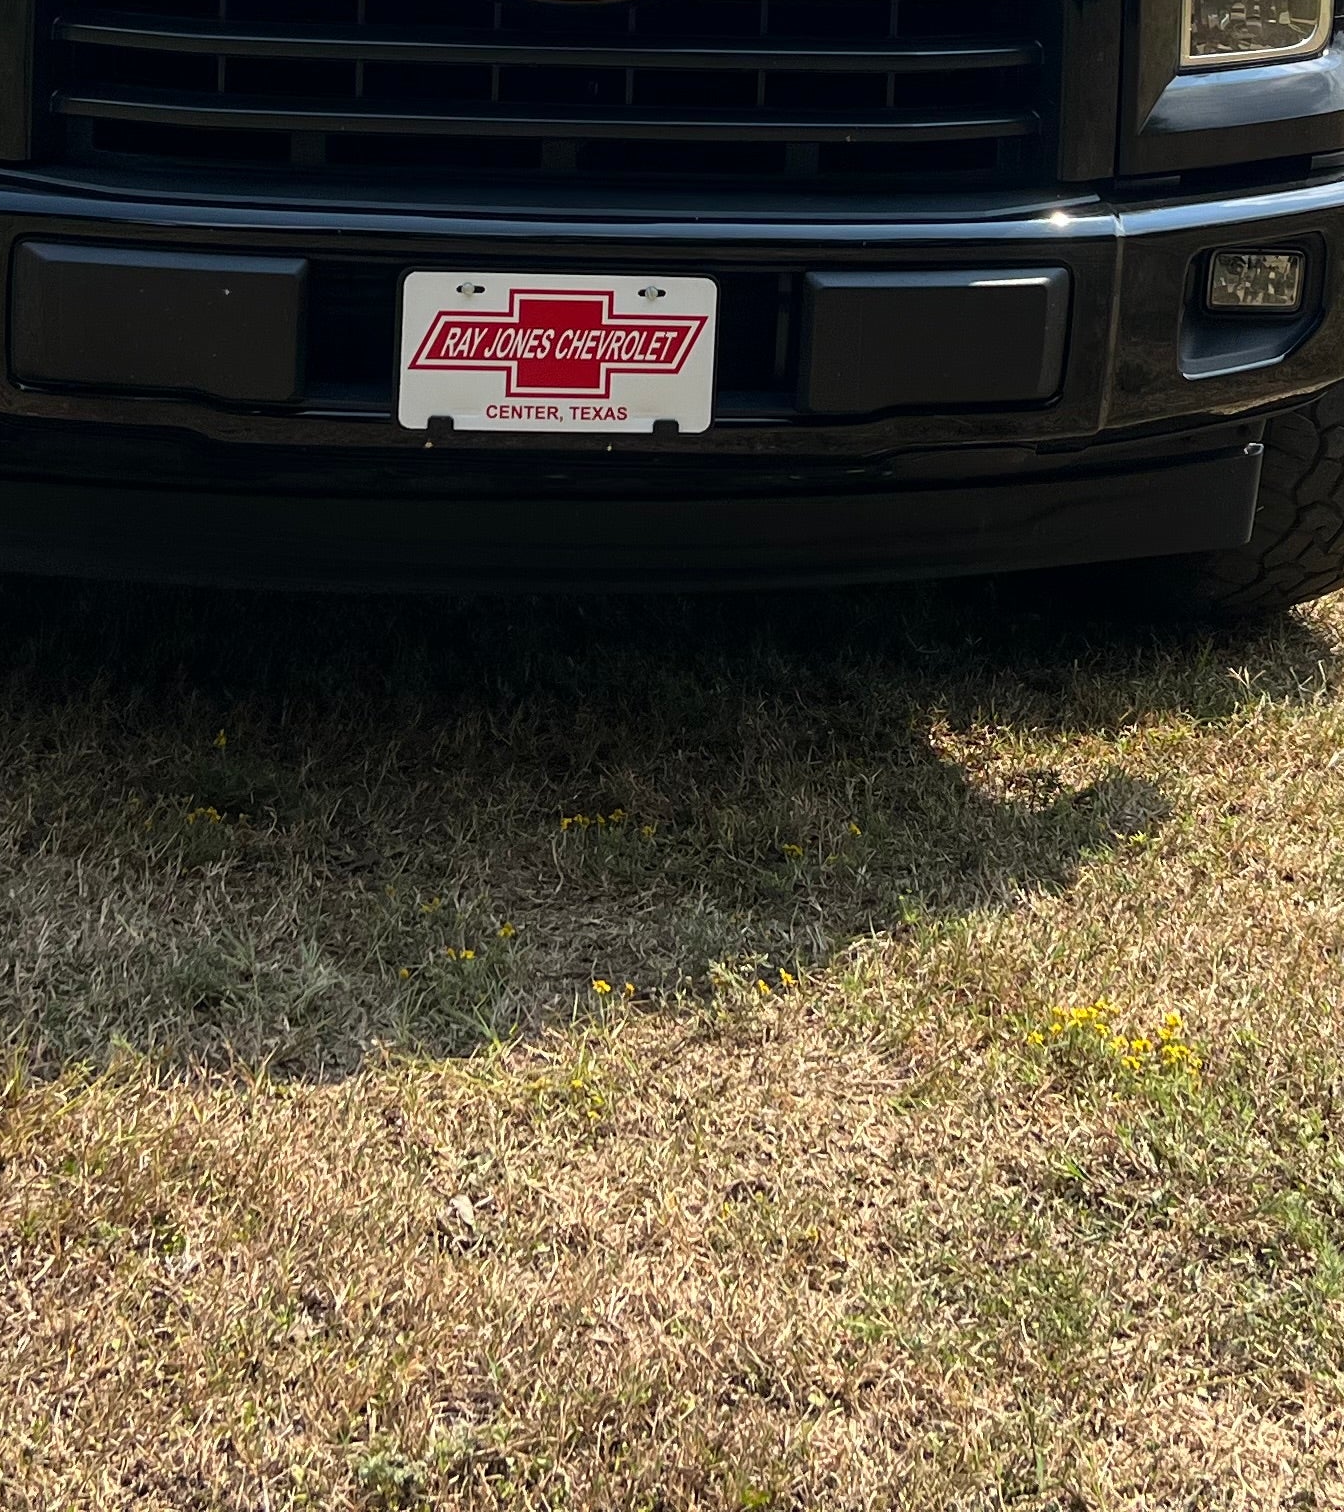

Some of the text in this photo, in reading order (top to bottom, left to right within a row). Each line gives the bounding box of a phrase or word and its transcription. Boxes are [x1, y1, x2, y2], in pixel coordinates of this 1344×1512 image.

[440, 326, 678, 362] RAY JONES CHEVROLET
[486, 404, 628, 422] CENTER, TEXAS
